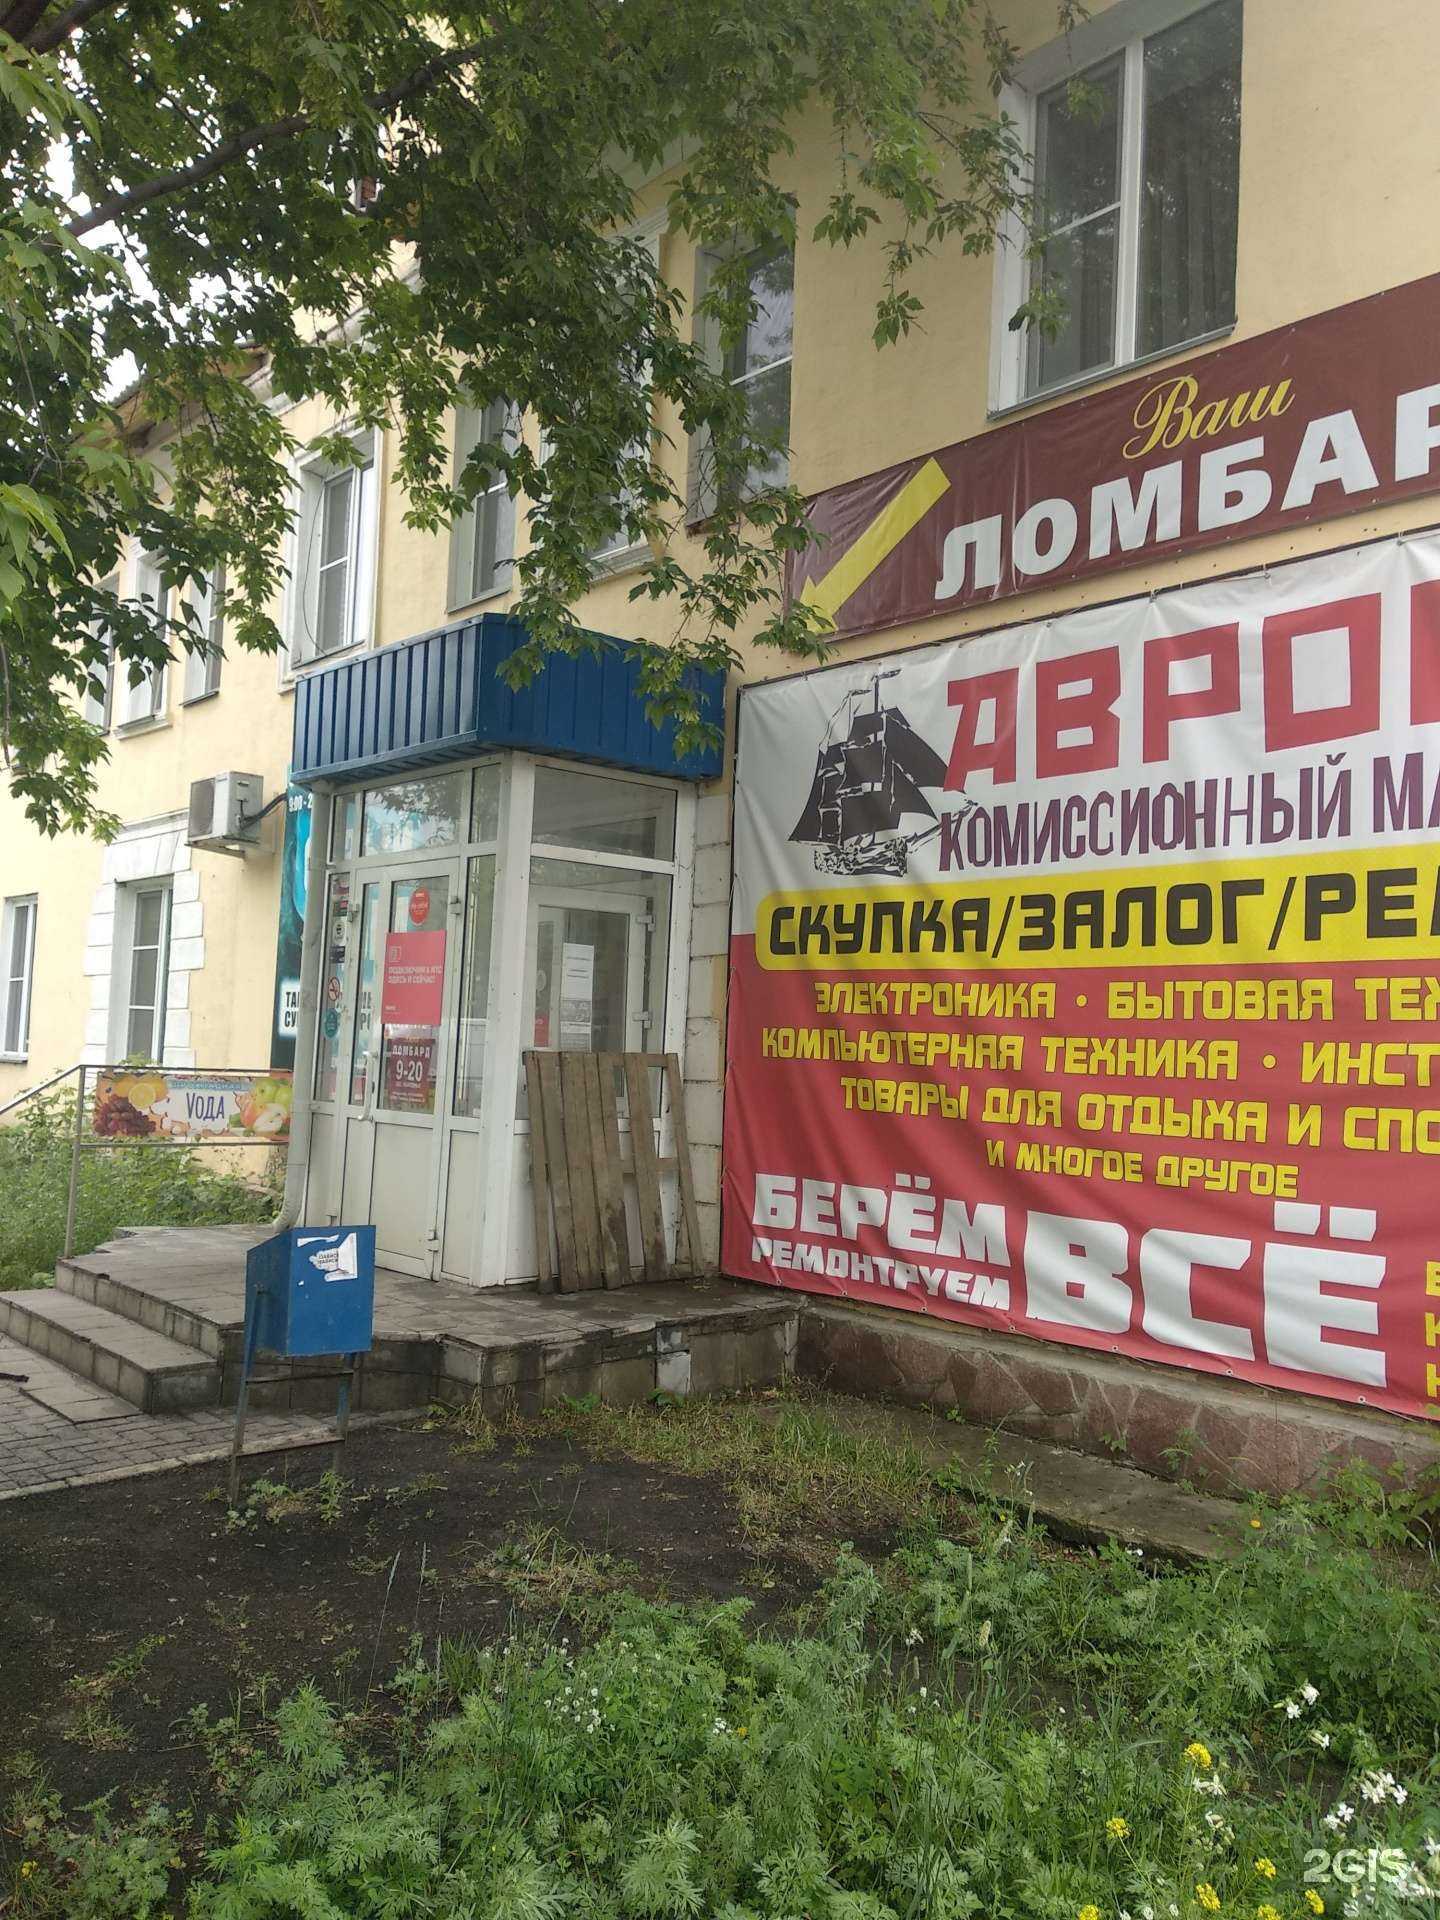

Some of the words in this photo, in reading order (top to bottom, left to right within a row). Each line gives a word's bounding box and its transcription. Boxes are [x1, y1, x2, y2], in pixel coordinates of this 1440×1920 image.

[1122, 374, 1296, 460] Ваш
[938, 751, 1352, 872] КОМИССИОННЫЙ
[1372, 752, 1440, 834] М
[814, 982, 1056, 1019] ЭЛЕКТРОНИКА
[1108, 979, 1333, 1021] БЫТОВАЯ
[395, 1059, 423, 1082] 9-20
[762, 1027, 1025, 1071] КОМПЬЮТЕРНАЯ
[1040, 1036, 1239, 1081] ТЕХНИКА
[840, 1077, 970, 1120] ТОВАРЫ
[981, 1087, 1063, 1128] ДЛЯ
[1077, 1092, 1268, 1143] ОТДЫХА
[1287, 1103, 1322, 1147] И
[986, 1140, 1006, 1168] И
[1015, 1142, 1144, 1183] МНОГОЕ
[1155, 1155, 1299, 1198] ДРУГОЕ
[752, 1173, 1011, 1267] БЕРЁМ
[751, 1236, 1011, 1312] РЕМОНТРУЕМ
[1024, 1201, 1387, 1388] ВСЁ
